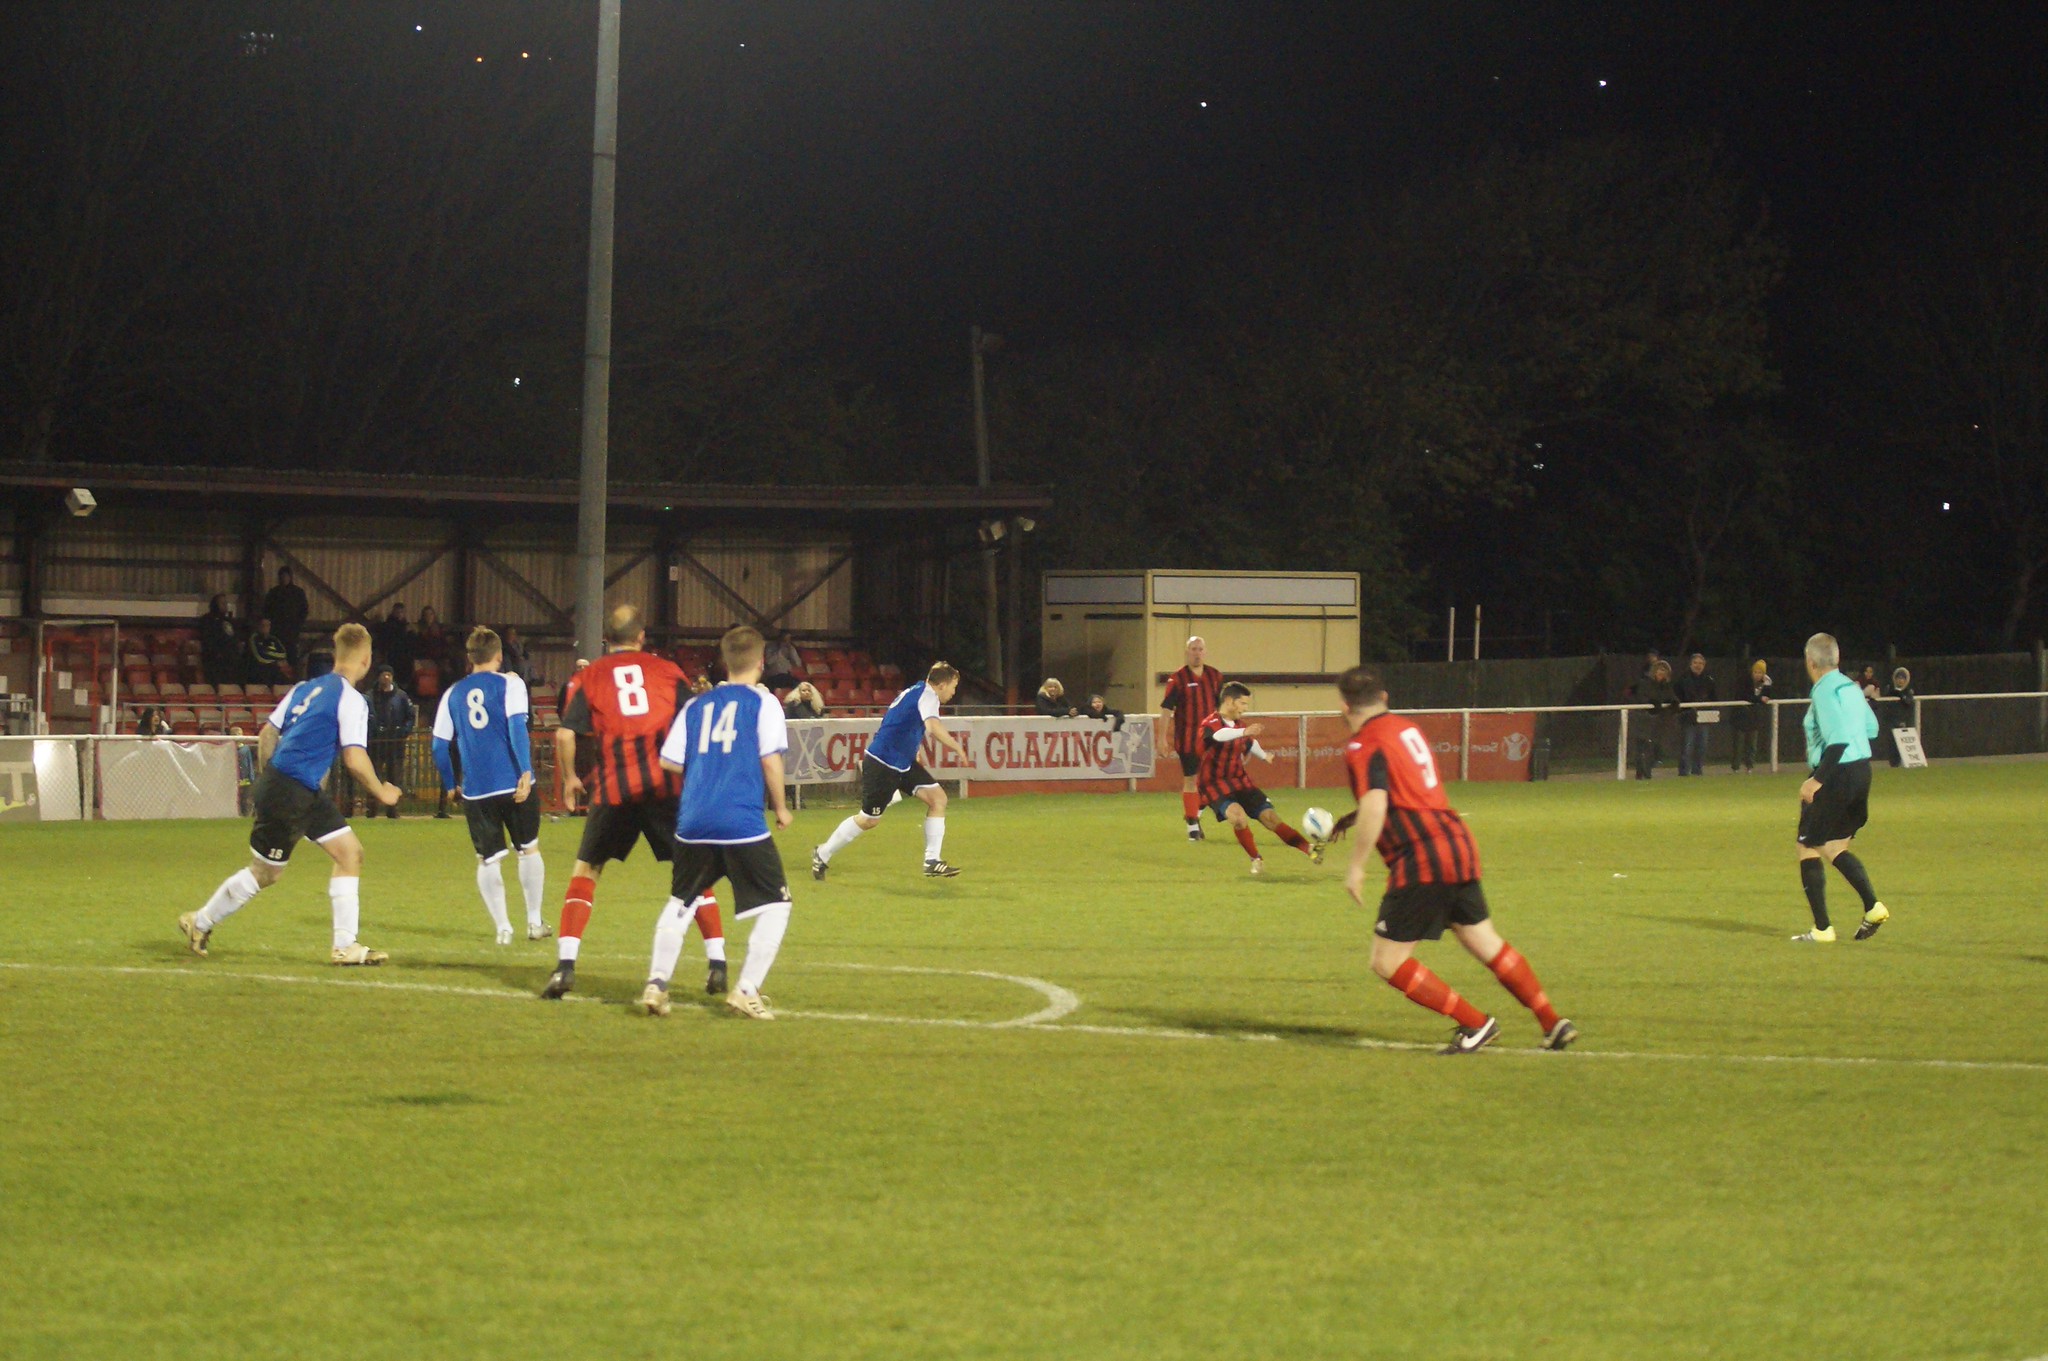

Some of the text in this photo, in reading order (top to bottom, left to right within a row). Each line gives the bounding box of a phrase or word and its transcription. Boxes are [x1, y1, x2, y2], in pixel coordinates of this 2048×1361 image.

[466, 688, 489, 729] 8
[613, 664, 649, 716] 8
[698, 701, 737, 754] 14
[827, 730, 1114, 771] CHNEL GLAZING
[1400, 727, 1438, 789] 9
